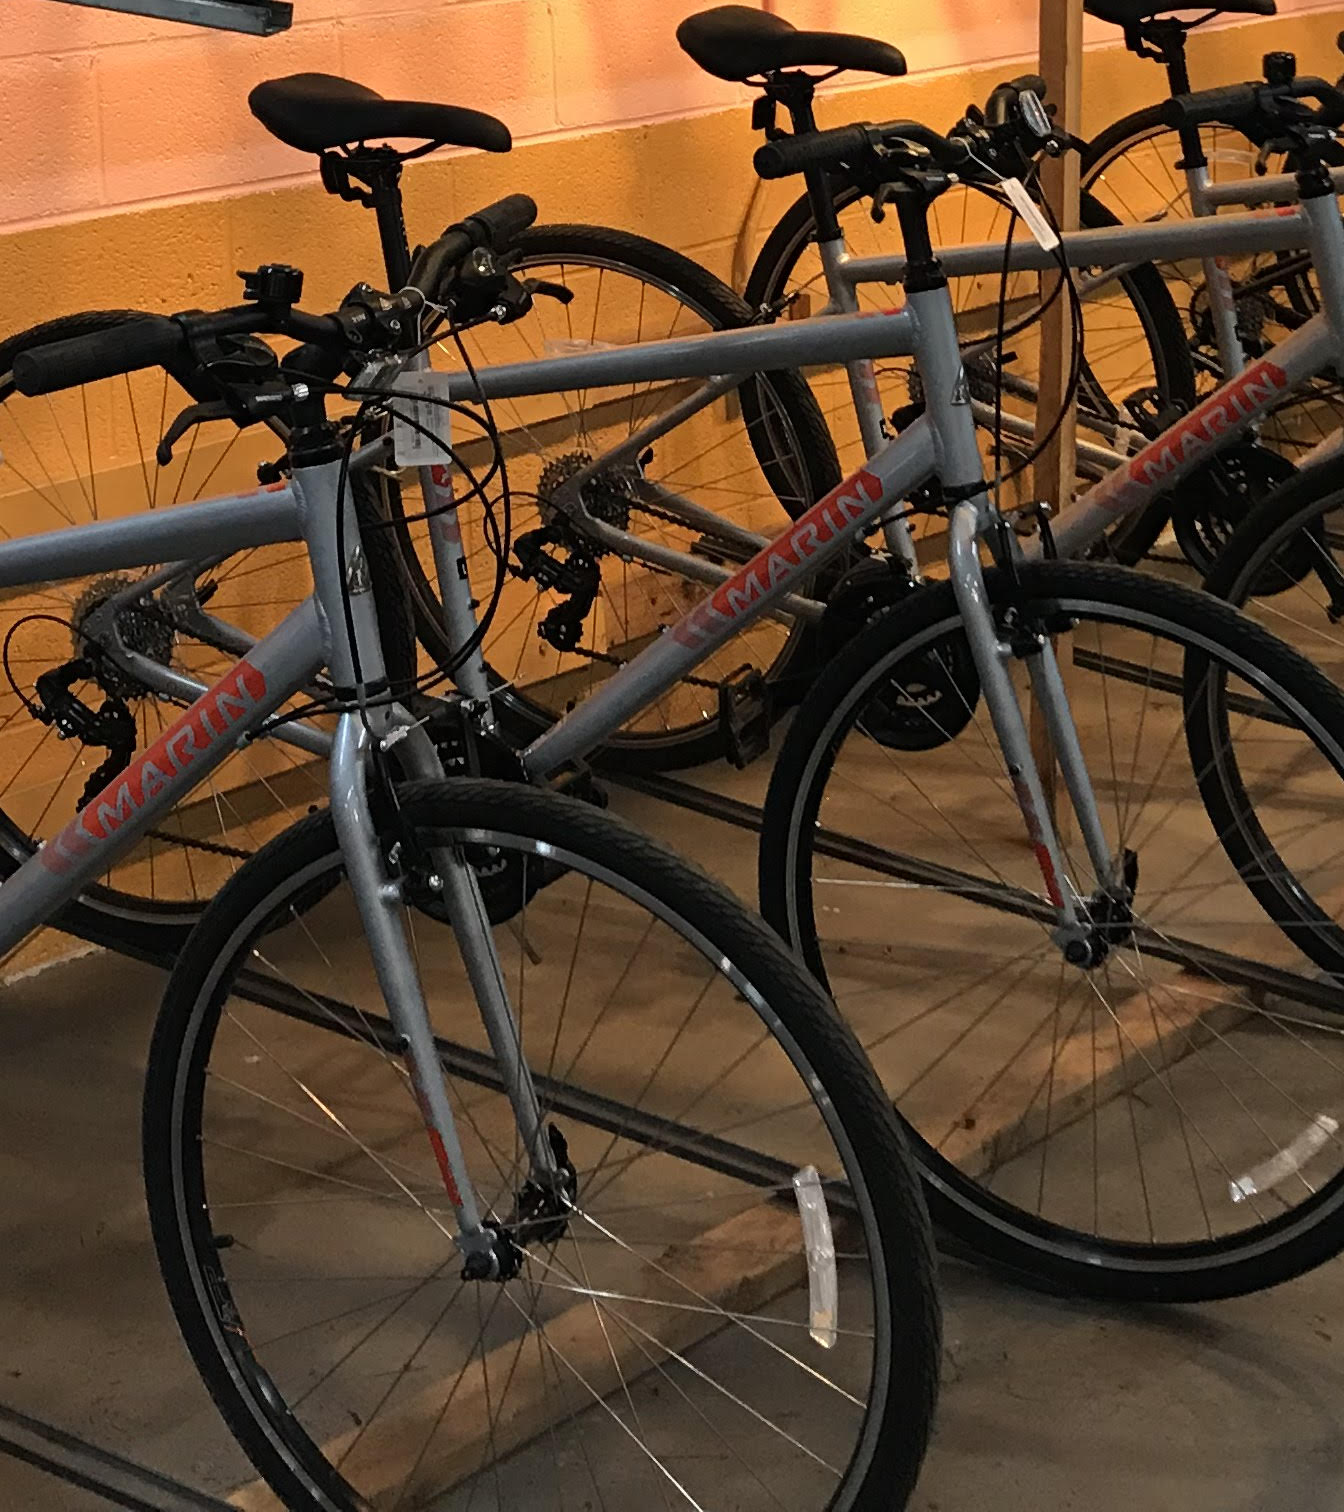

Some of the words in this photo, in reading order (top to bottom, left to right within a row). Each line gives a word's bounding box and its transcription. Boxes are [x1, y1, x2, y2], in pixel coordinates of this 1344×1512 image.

[1143, 370, 1281, 482] MARIN
[726, 480, 875, 618] MARIN
[96, 674, 259, 836] MARIN
